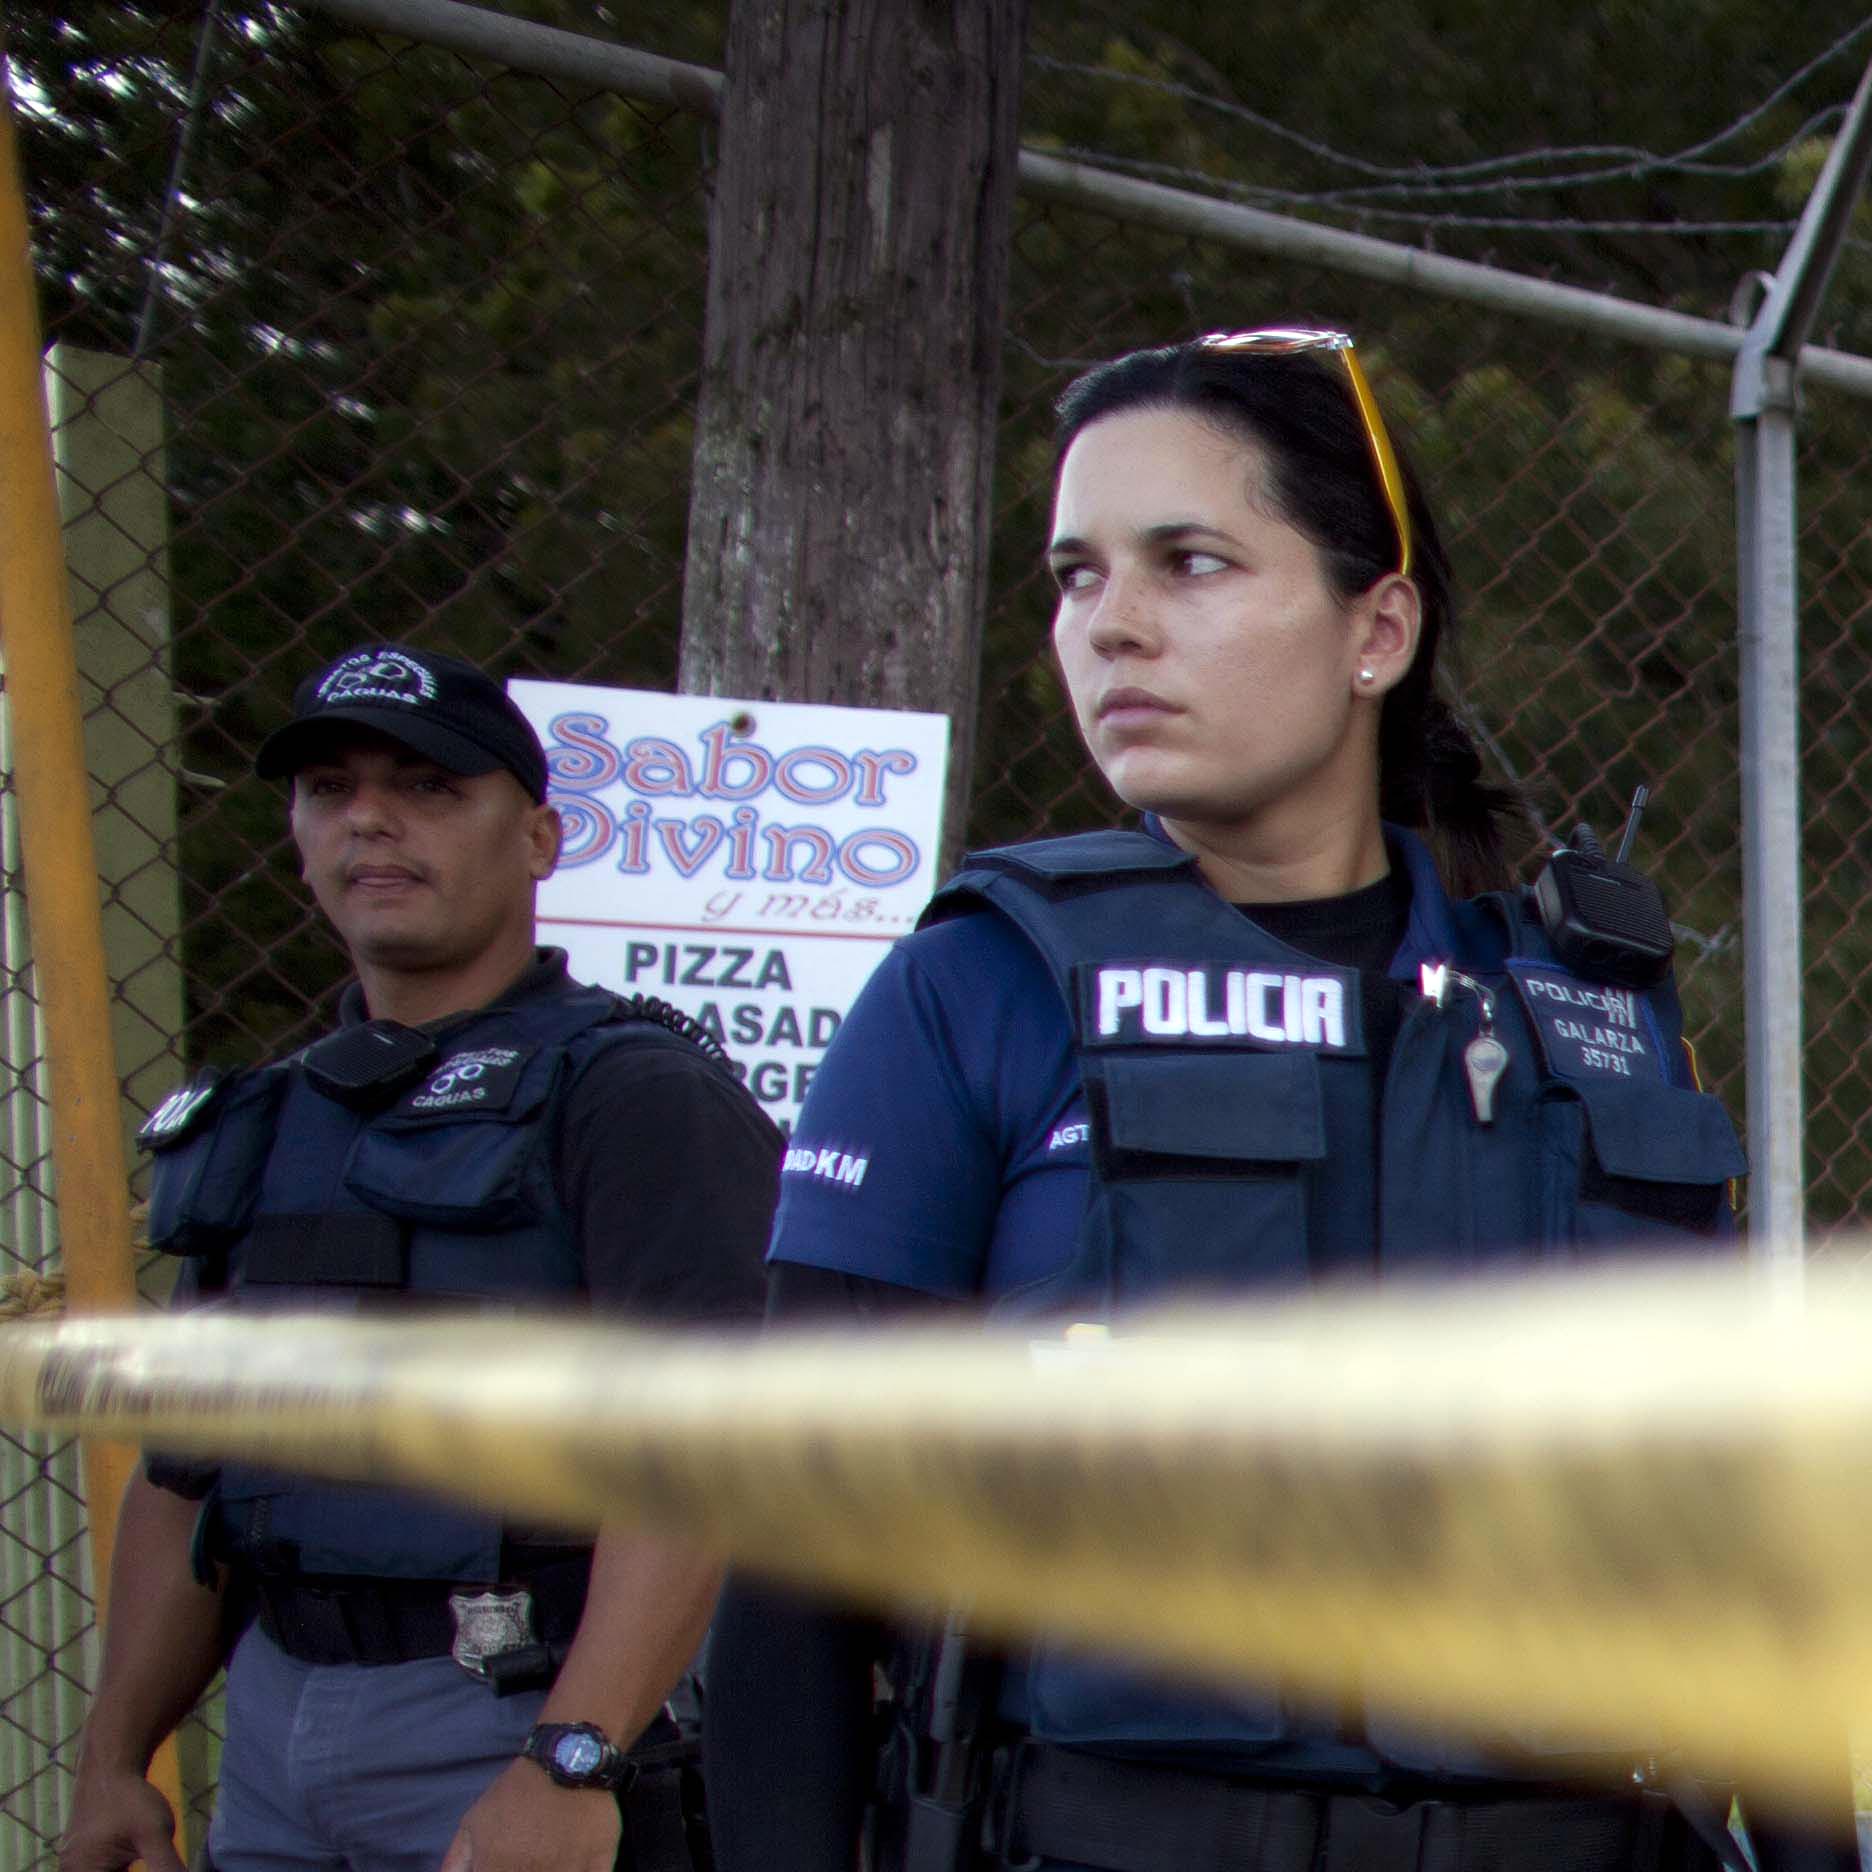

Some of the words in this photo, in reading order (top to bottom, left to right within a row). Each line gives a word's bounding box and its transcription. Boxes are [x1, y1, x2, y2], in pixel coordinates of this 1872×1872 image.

[549, 712, 918, 807] Sabor
[550, 792, 920, 888] Divino
[701, 889, 742, 923] y
[625, 942, 792, 990] PIZZA
[697, 1001, 843, 1048] ASAD
[1098, 968, 1346, 1047] POLICIA
[1554, 1018, 1646, 1055] GALARZA
[412, 1088, 487, 1107] CAGUAS
